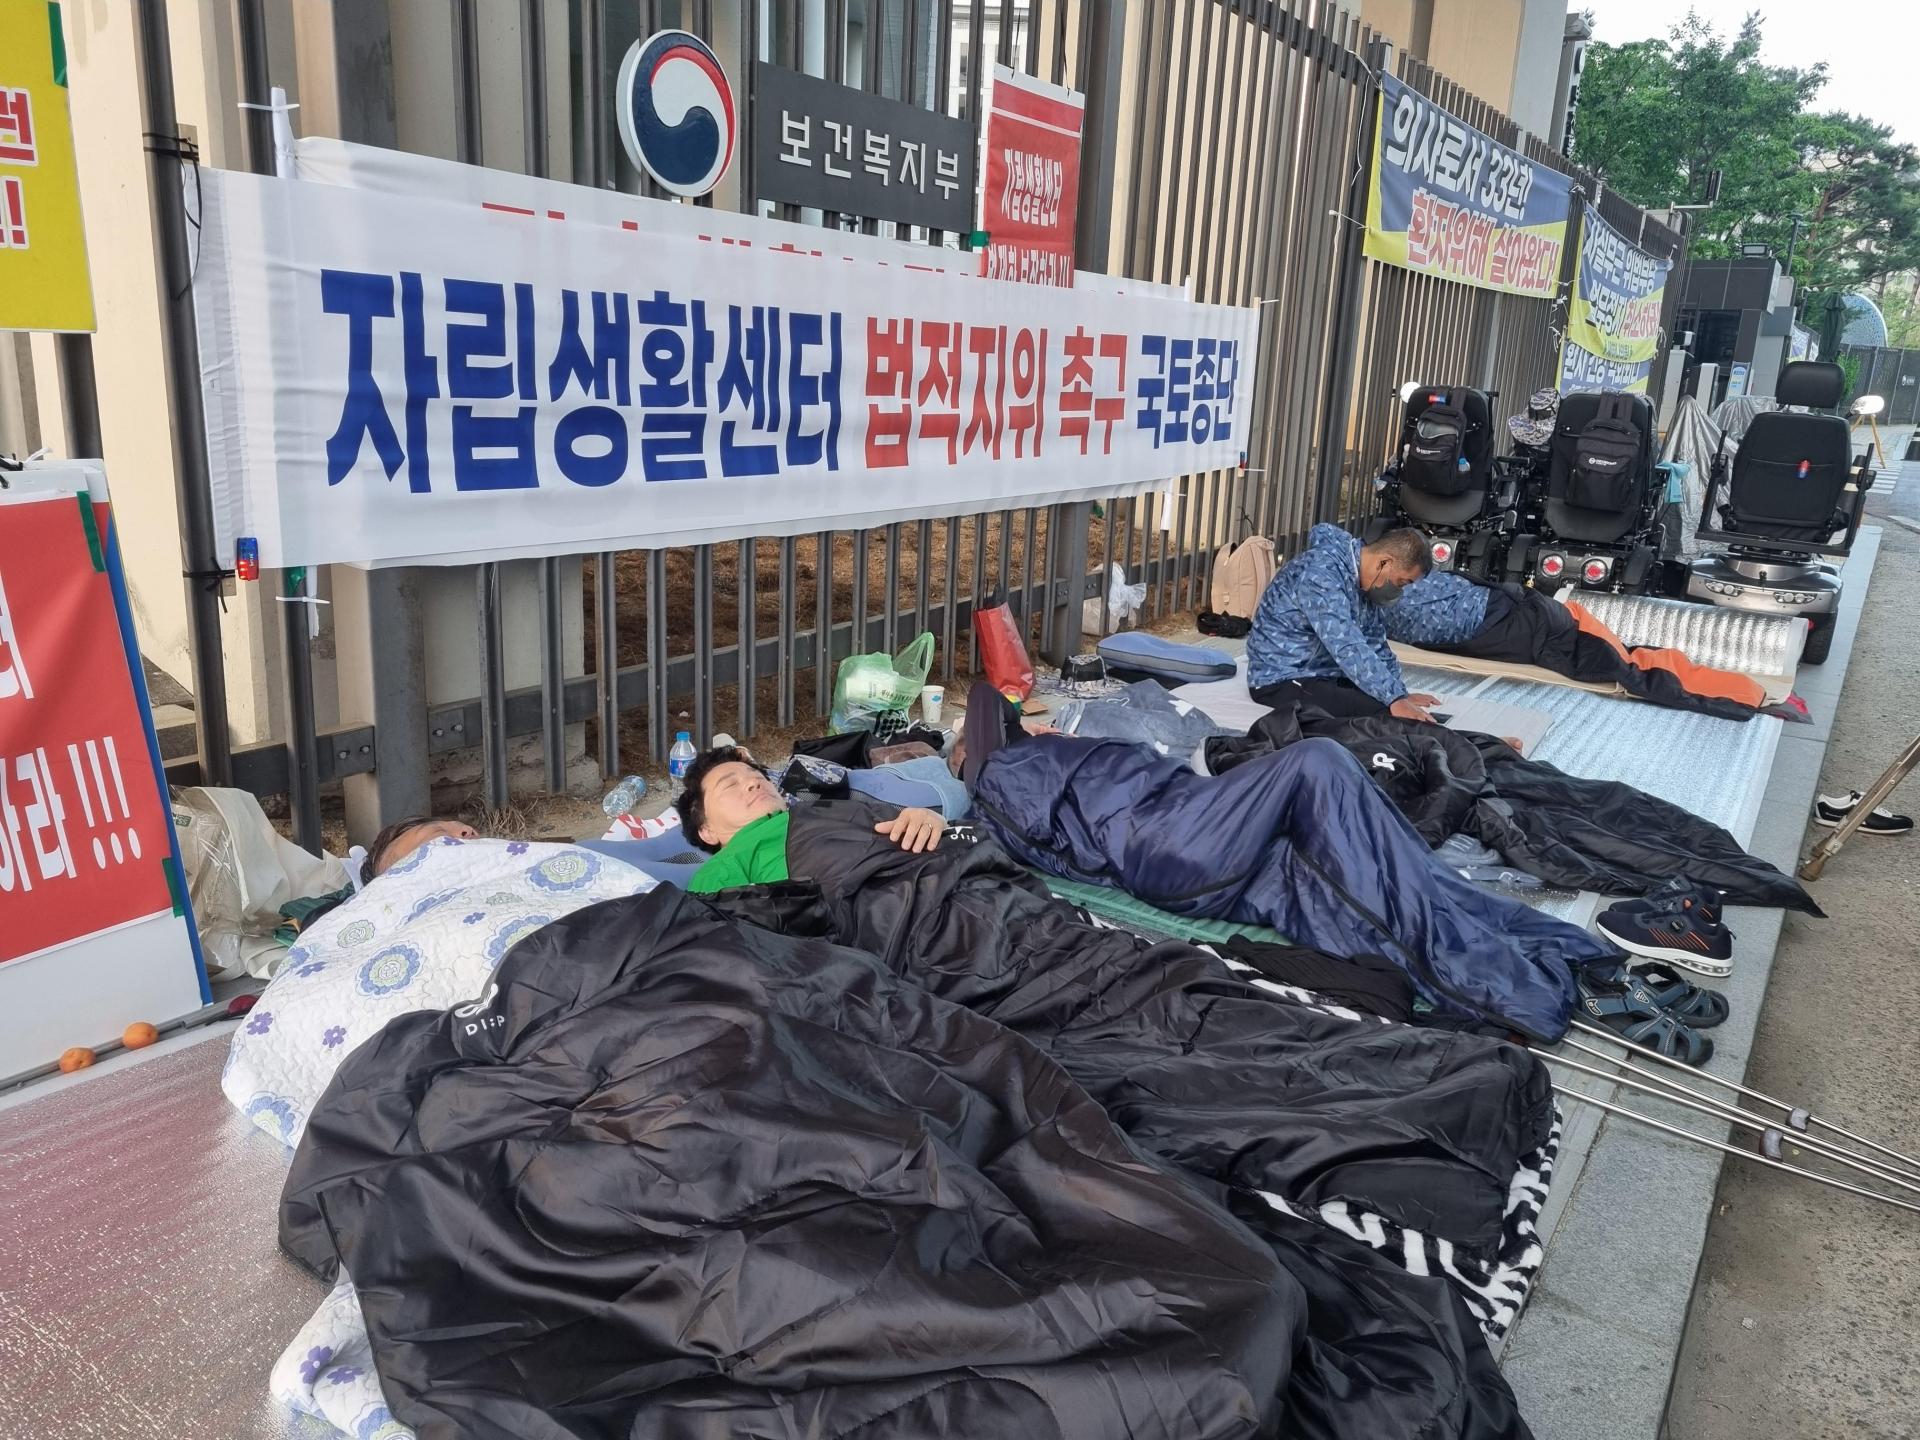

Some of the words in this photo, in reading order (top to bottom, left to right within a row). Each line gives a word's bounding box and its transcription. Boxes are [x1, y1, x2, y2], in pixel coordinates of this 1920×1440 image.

[779, 110, 960, 200] 보건복지부
[1001, 148, 1063, 229] 자립생활센터
[1386, 94, 1486, 202] 의사로서
[1480, 148, 1533, 221] 33년!
[1408, 189, 1497, 282] 환자위해
[320, 269, 842, 495] 자립생활센터
[865, 316, 1048, 469] 법적지위
[1059, 326, 1128, 455] 촉구
[1137, 334, 1238, 449] 국토종단
